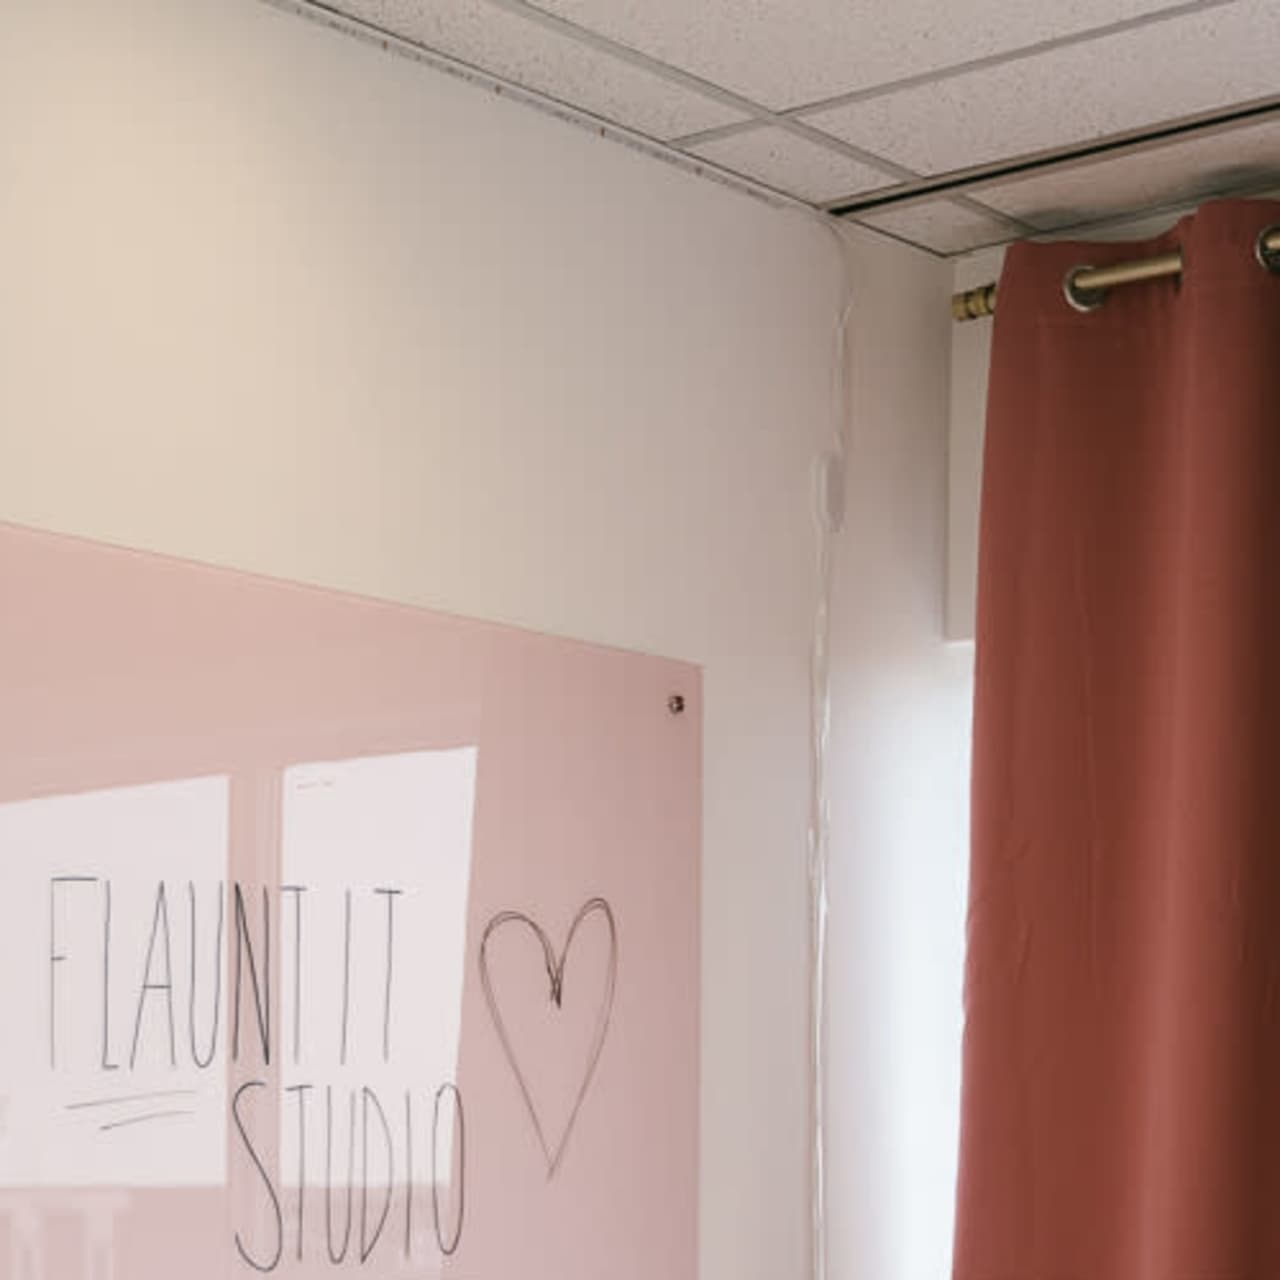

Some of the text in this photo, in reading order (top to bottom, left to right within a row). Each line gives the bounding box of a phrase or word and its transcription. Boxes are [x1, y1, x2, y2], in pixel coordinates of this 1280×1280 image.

[51, 876, 402, 1069] FLAUNT IT
[232, 1079, 465, 1273] STUDIO
